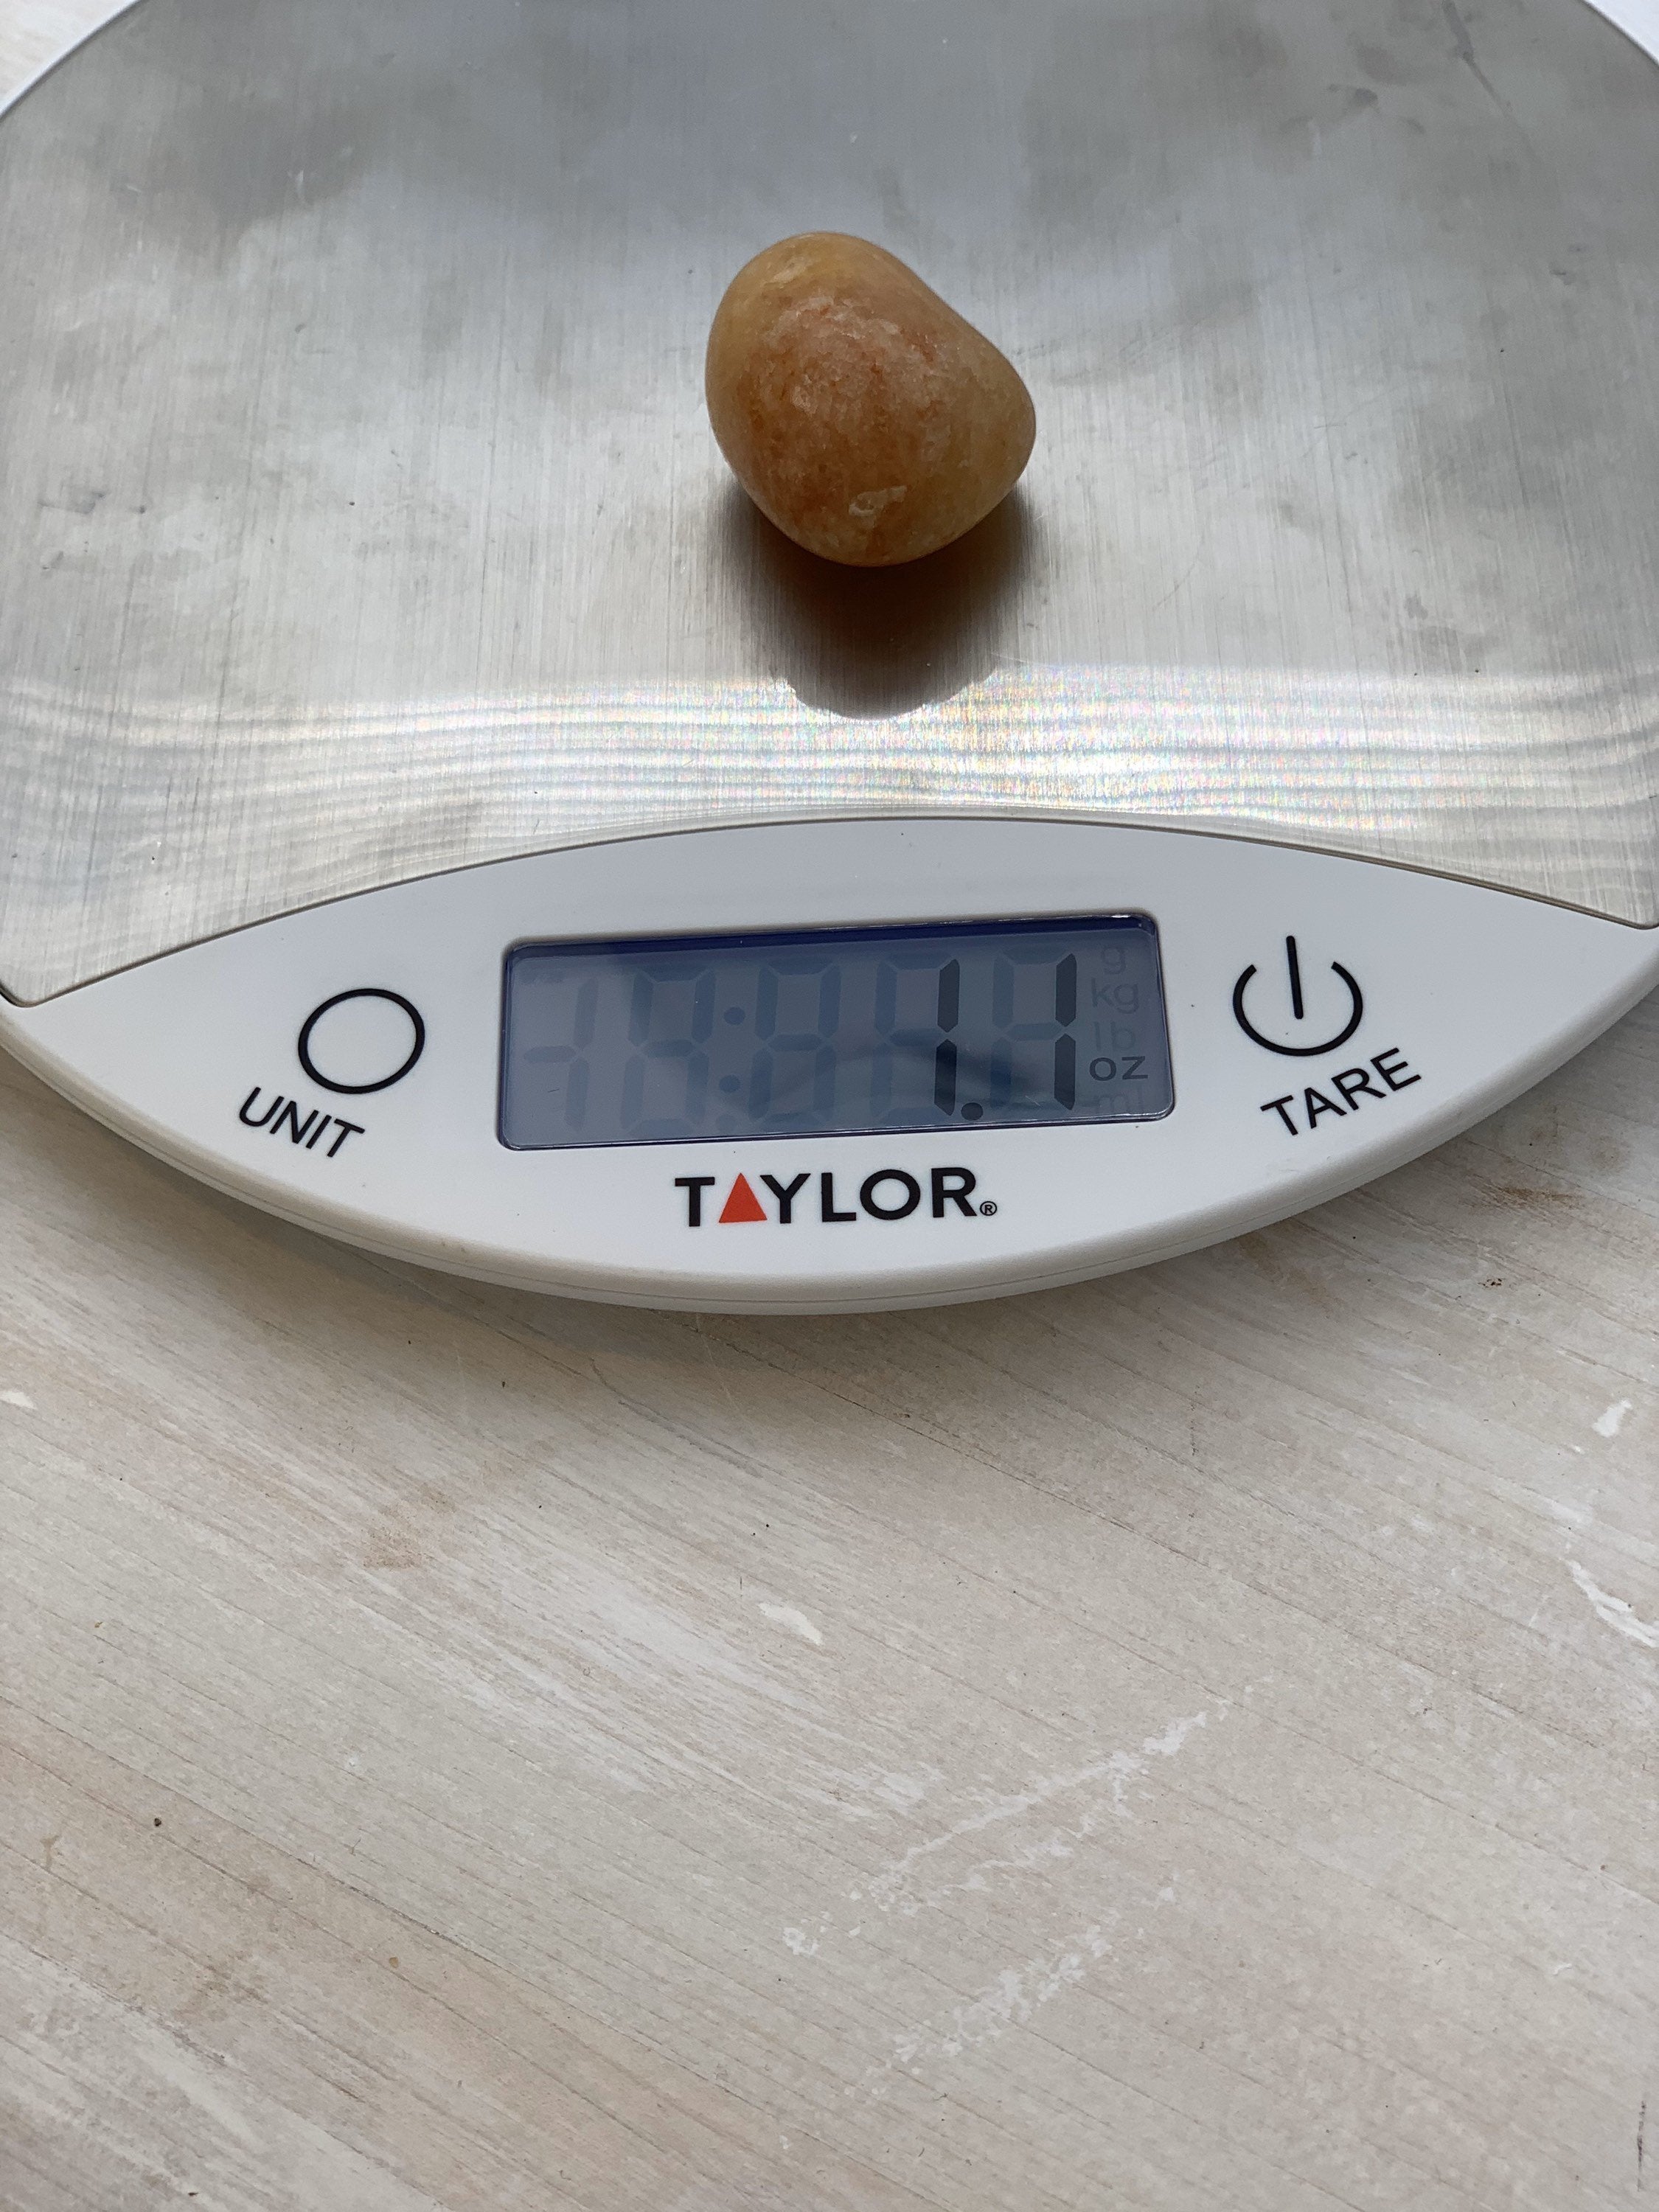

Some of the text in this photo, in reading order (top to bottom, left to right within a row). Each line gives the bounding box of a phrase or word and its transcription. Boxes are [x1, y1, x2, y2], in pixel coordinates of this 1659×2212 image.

[1091, 977, 1139, 1015] kg
[934, 953, 1077, 1120] 1.1
[1089, 1056, 1149, 1081] oz
[239, 1086, 366, 1158] UNIT
[1259, 1047, 1422, 1136] TARE
